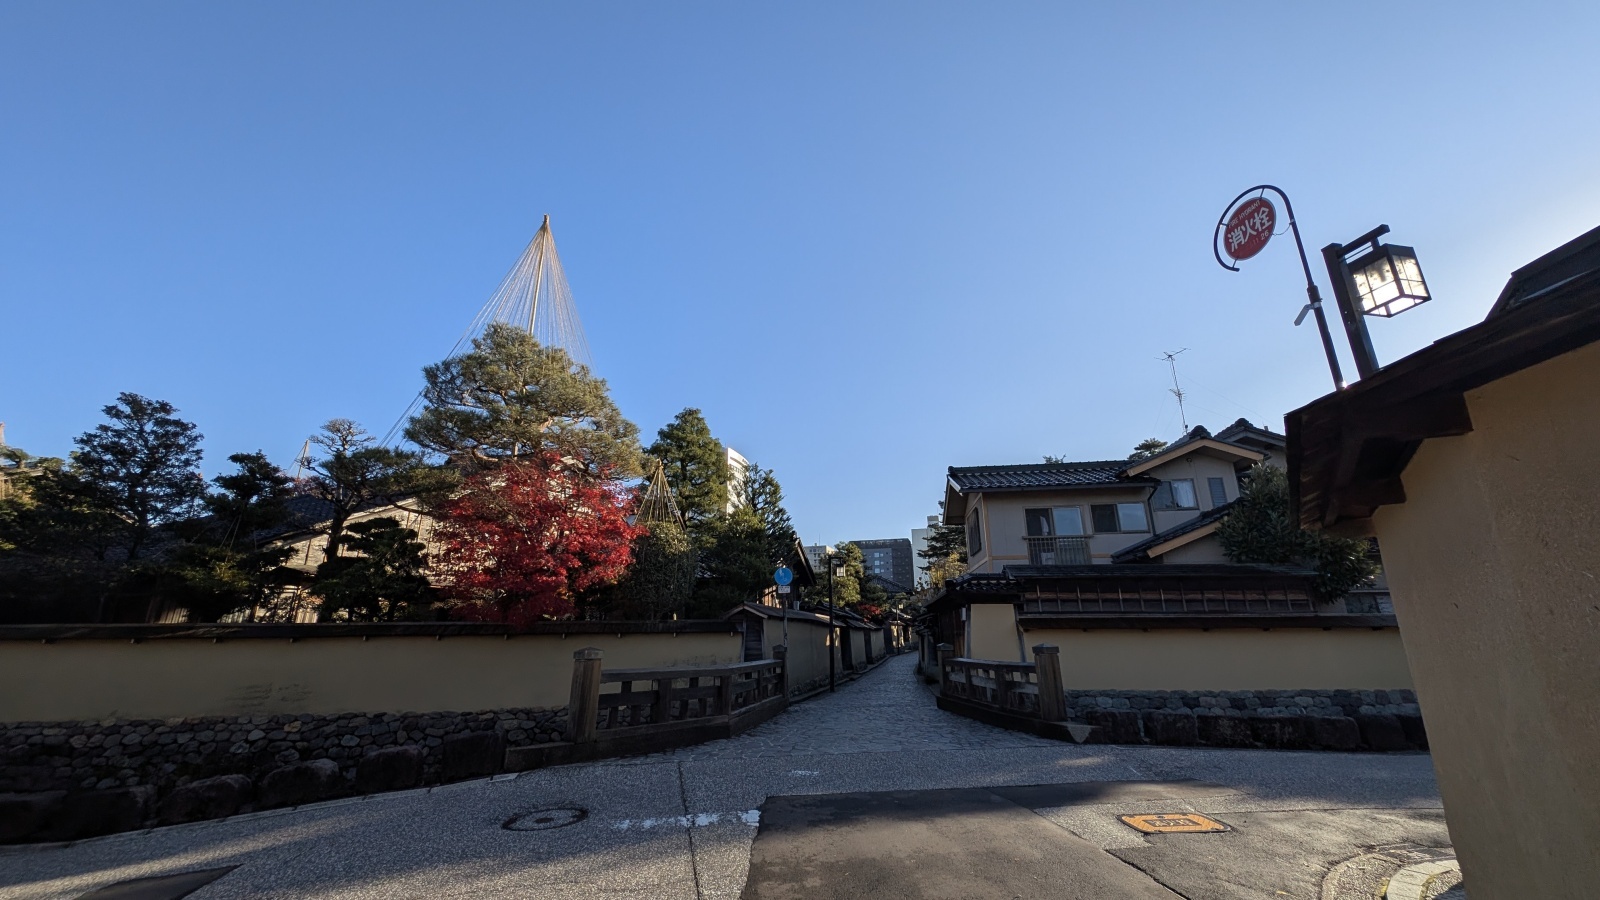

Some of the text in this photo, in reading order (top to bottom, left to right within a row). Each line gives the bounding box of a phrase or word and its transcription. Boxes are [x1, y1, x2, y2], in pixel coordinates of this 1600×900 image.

[1239, 200, 1261, 220] HYDRANT
[1227, 207, 1272, 252] 消火栓
